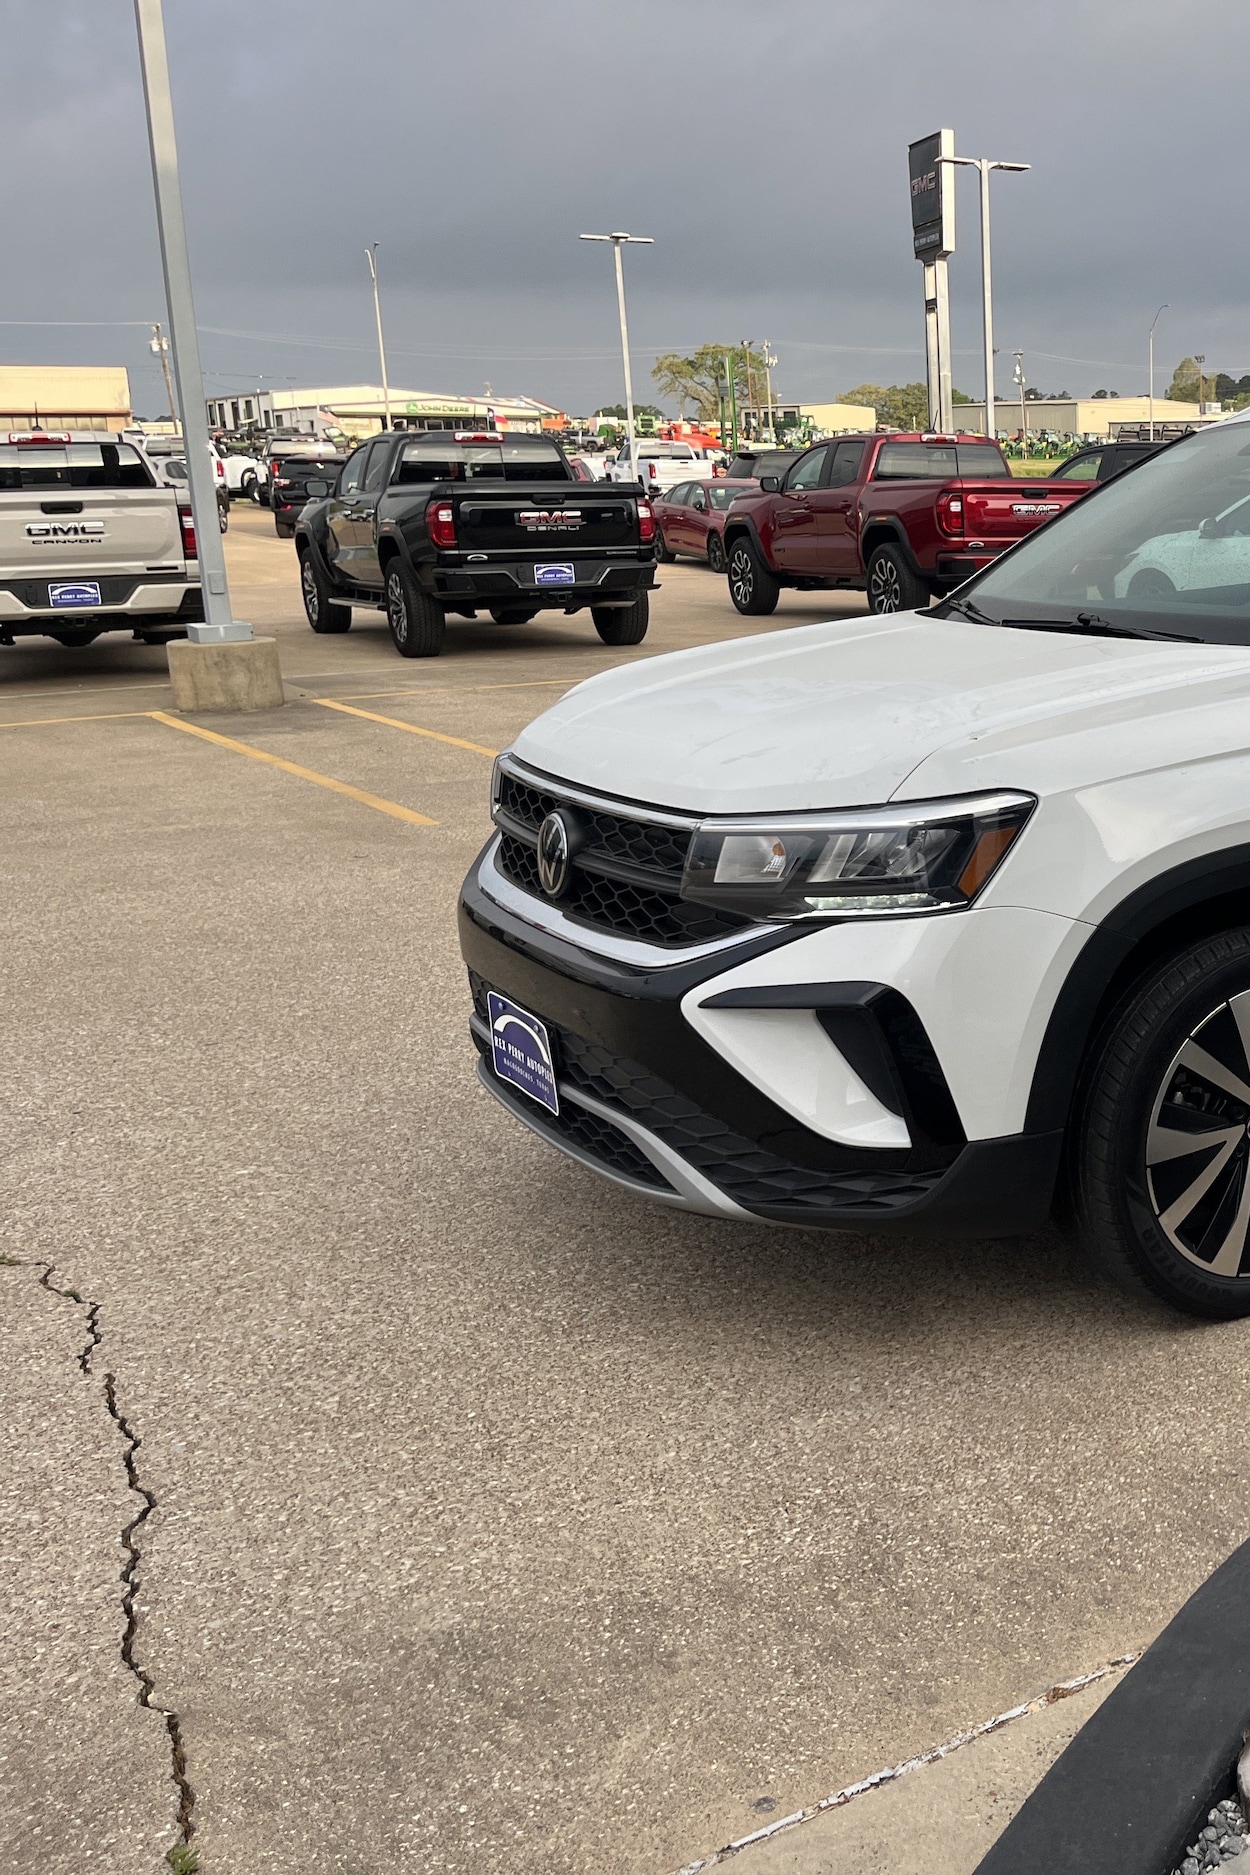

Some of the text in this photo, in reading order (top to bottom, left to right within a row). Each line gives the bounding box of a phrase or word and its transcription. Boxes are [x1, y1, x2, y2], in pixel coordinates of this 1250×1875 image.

[911, 171, 936, 197] GMC
[442, 404, 470, 412] DEERE
[1012, 504, 1060, 516] GMC
[520, 511, 582, 524] GMC
[25, 521, 105, 537] GMC
[494, 1035, 553, 1084] REX PERRY AUTOPLEX
